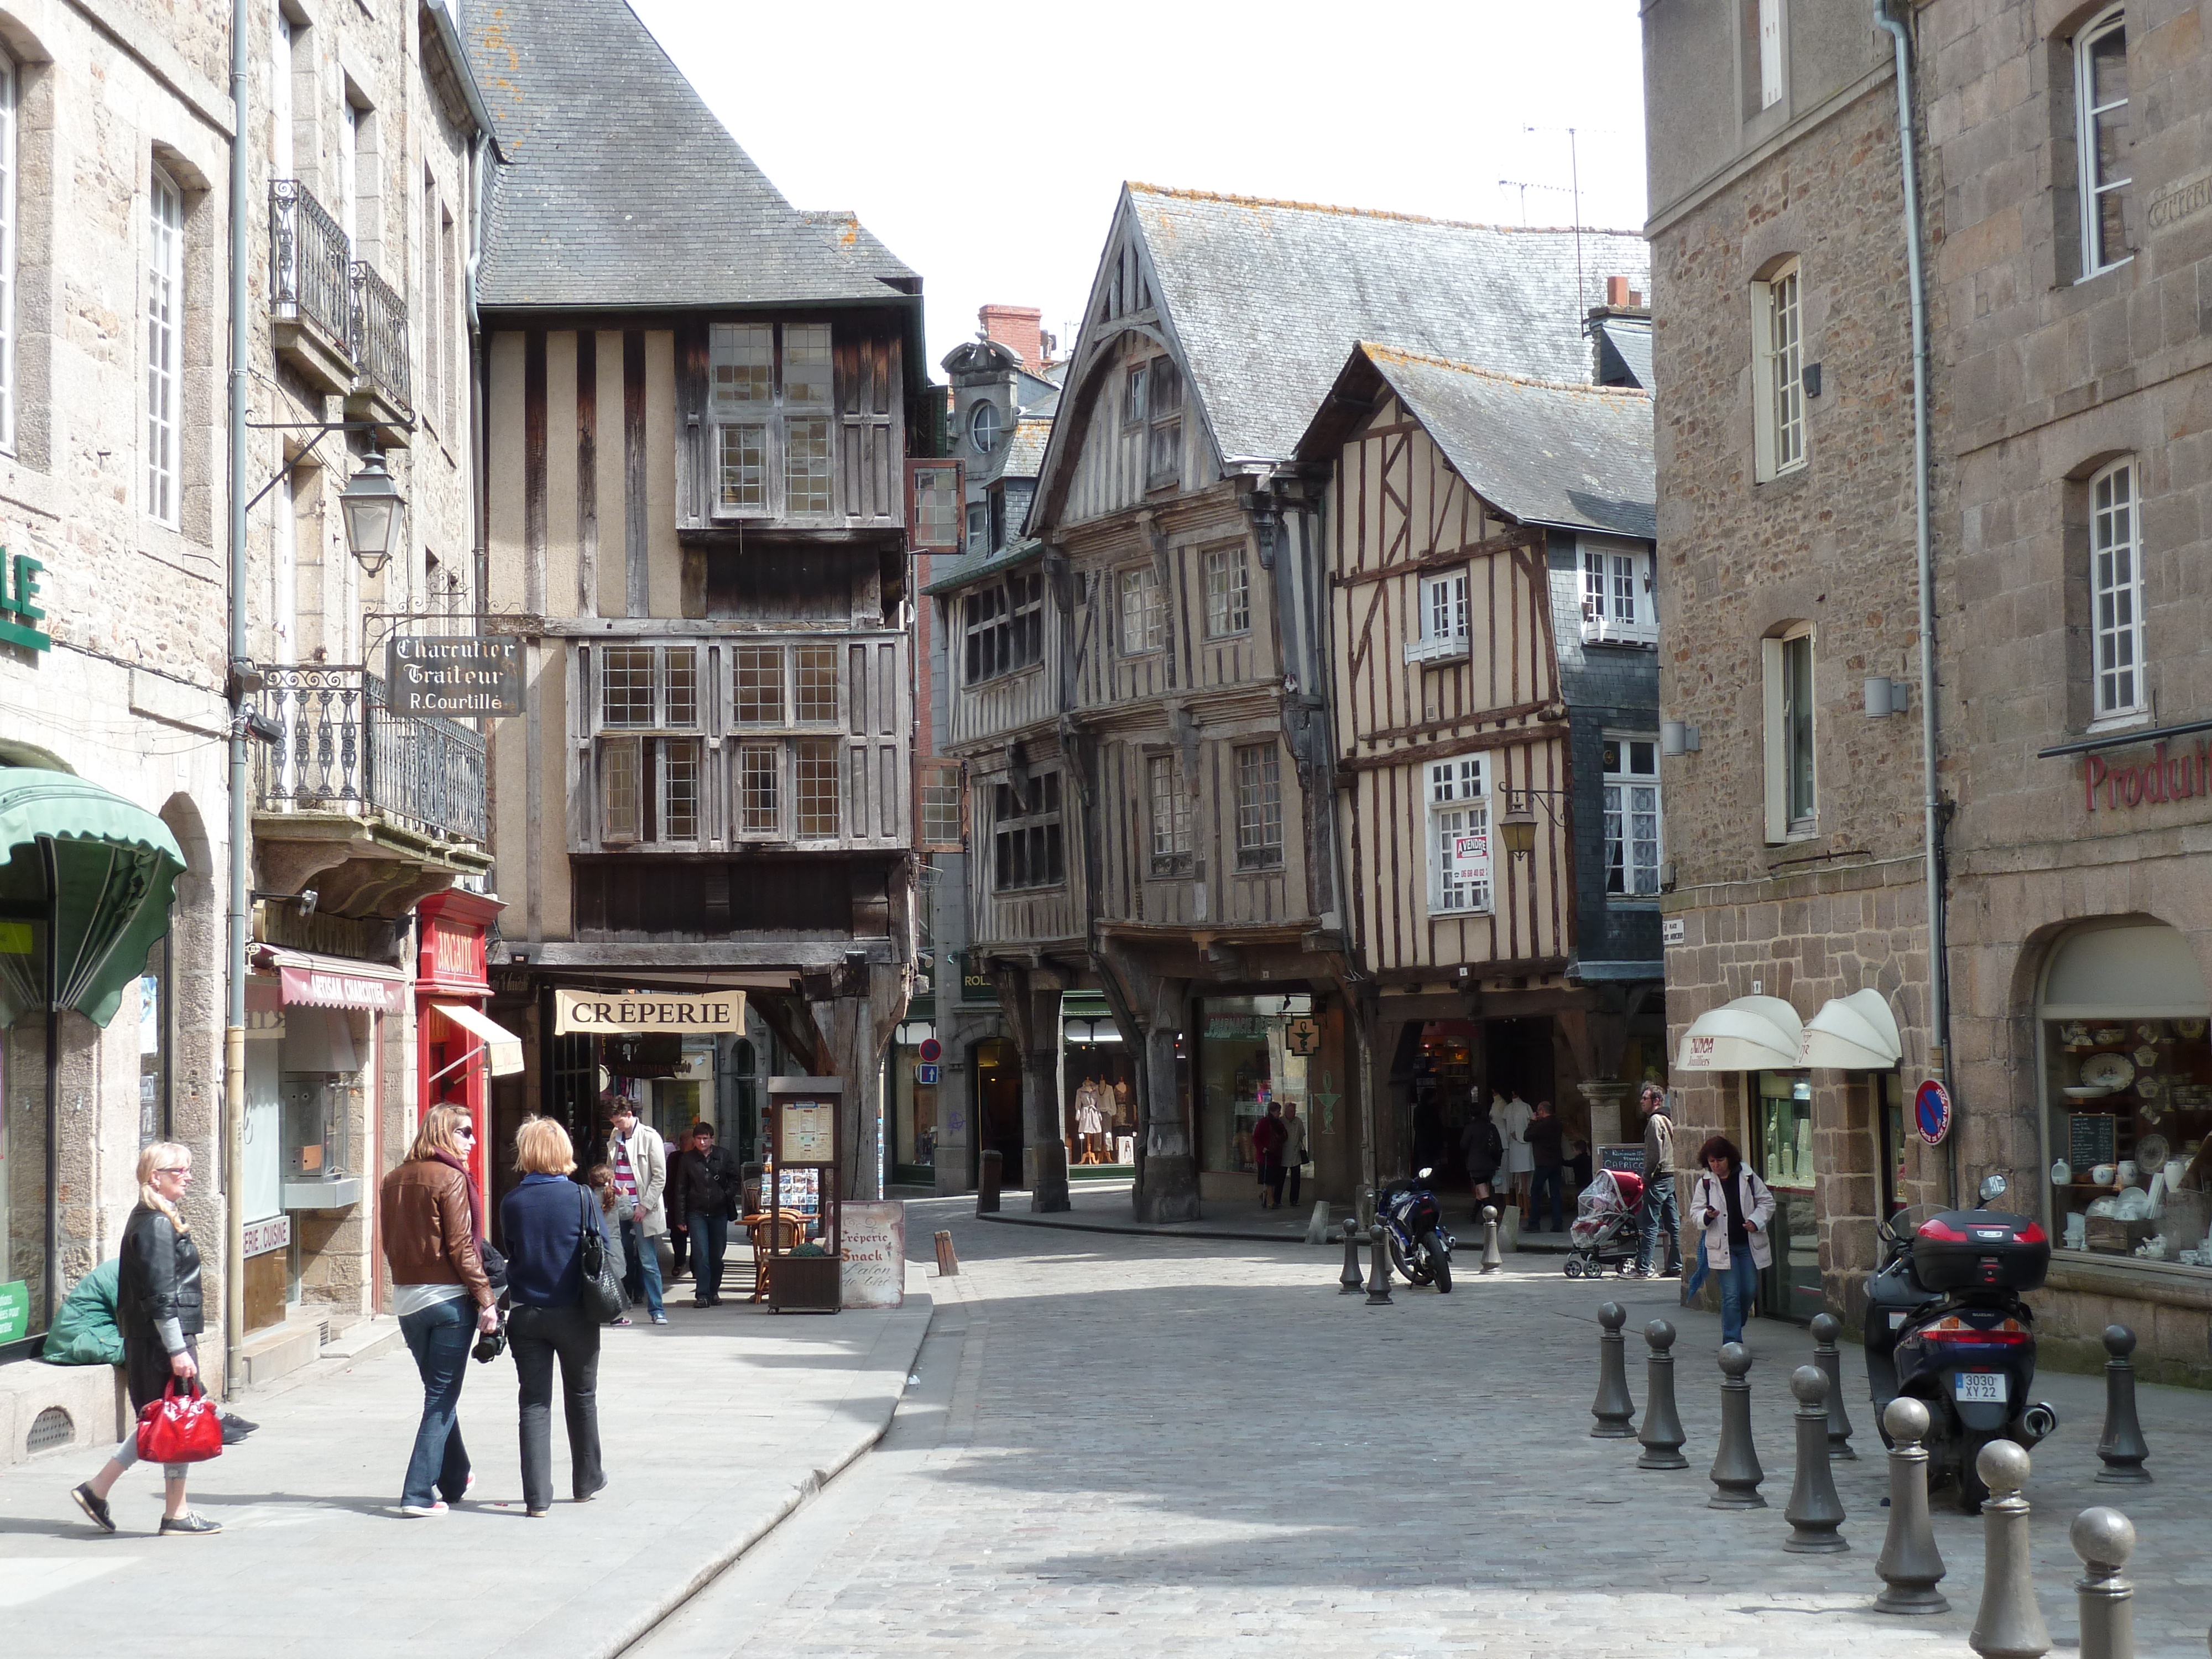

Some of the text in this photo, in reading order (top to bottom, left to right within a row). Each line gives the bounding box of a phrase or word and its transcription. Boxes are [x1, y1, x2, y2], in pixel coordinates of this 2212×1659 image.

[397, 639, 515, 659] Charcutier
[403, 664, 504, 684] Traiteur
[1463, 838, 1486, 851] VENDRE
[964, 975, 992, 986] ROL
[311, 974, 387, 1010] ARTISAN CHARCUTIER
[572, 999, 730, 1024] CRÊPERIE
[243, 1221, 287, 1254] ERIE CUISINE
[1965, 1375, 1994, 1386] 3030
[1966, 1386, 1996, 1397] XY 22
